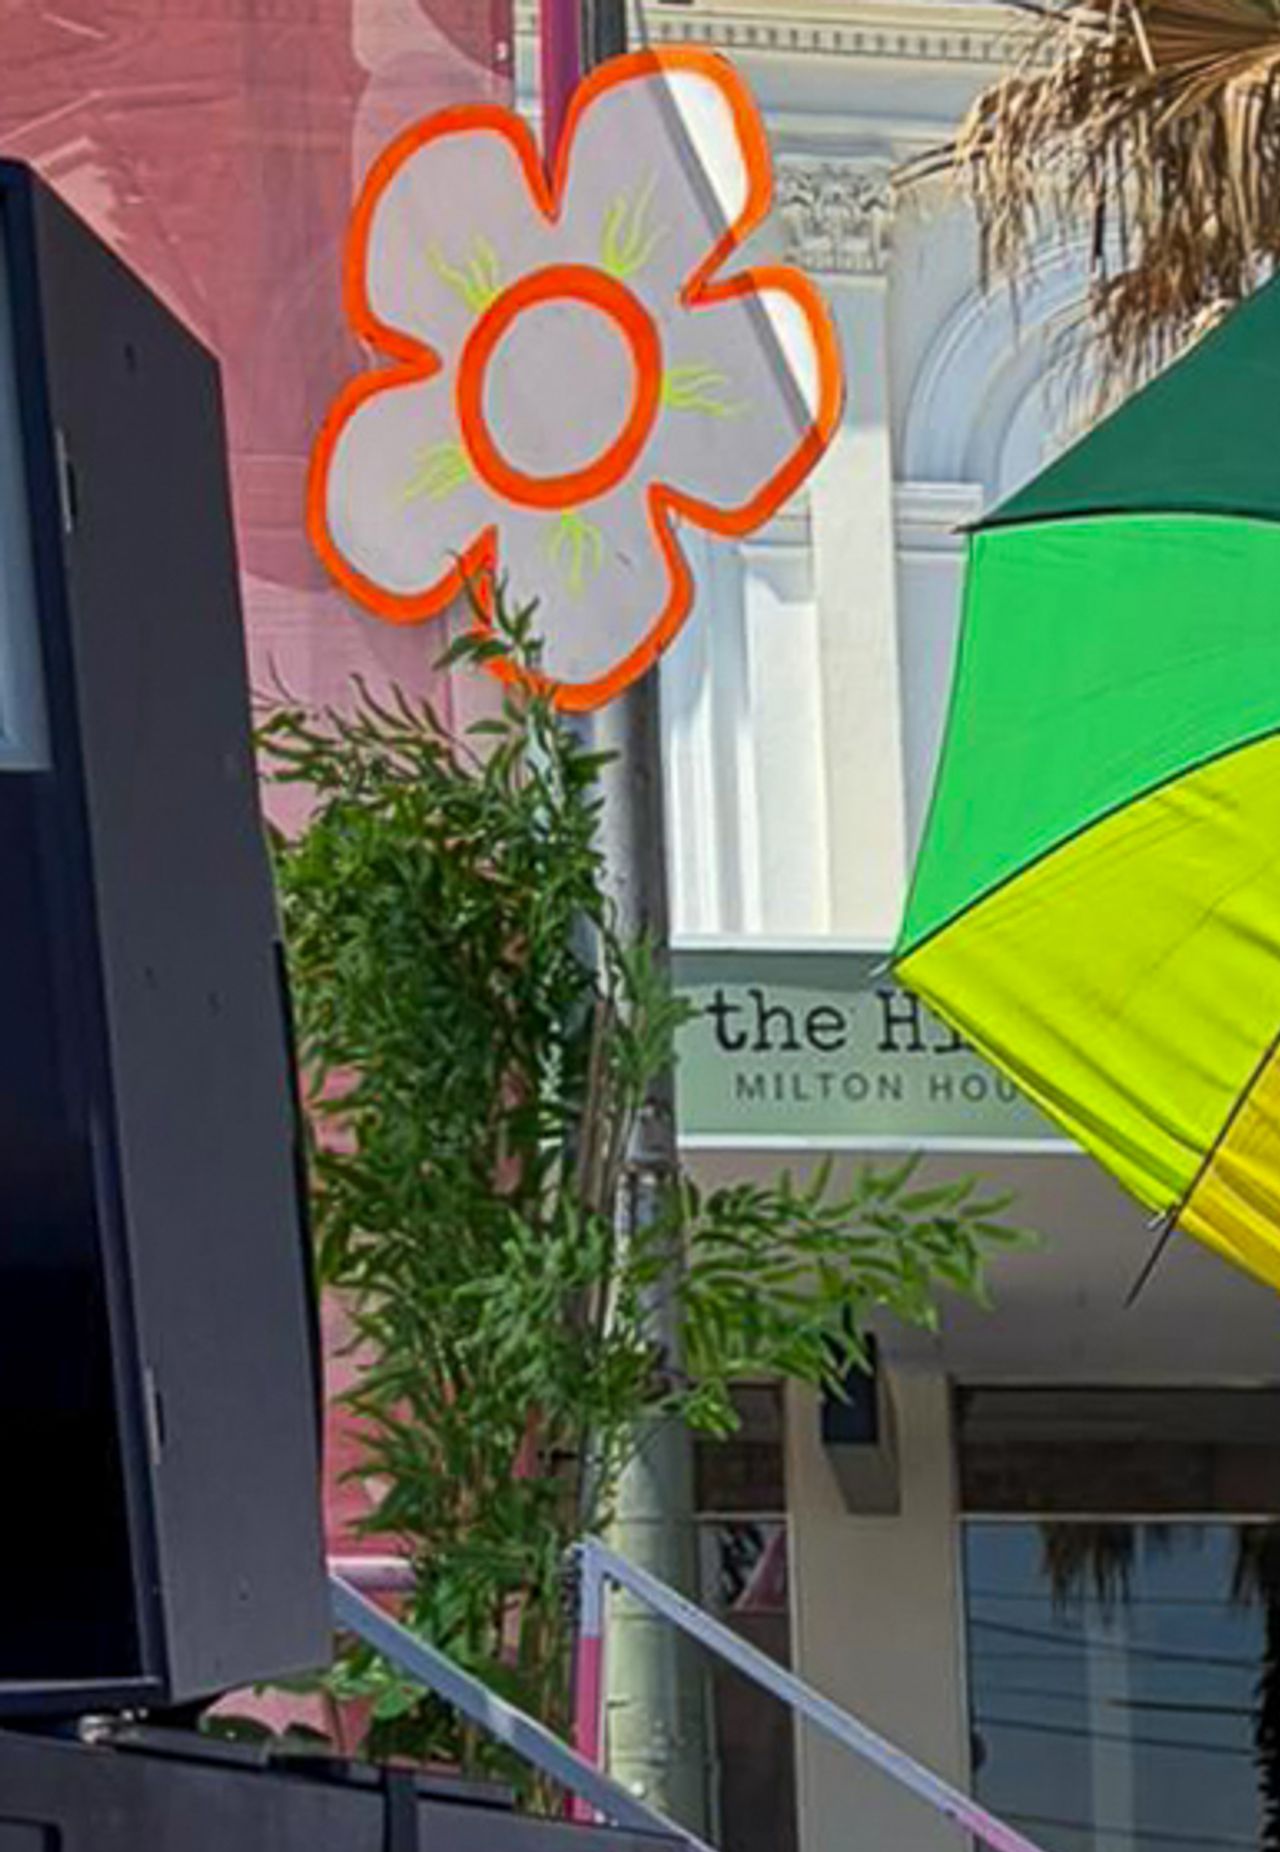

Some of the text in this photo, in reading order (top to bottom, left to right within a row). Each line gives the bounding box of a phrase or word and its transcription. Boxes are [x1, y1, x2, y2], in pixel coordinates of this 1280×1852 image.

[705, 988, 848, 1052] the
[735, 1073, 1017, 1102] MILTON HOU
